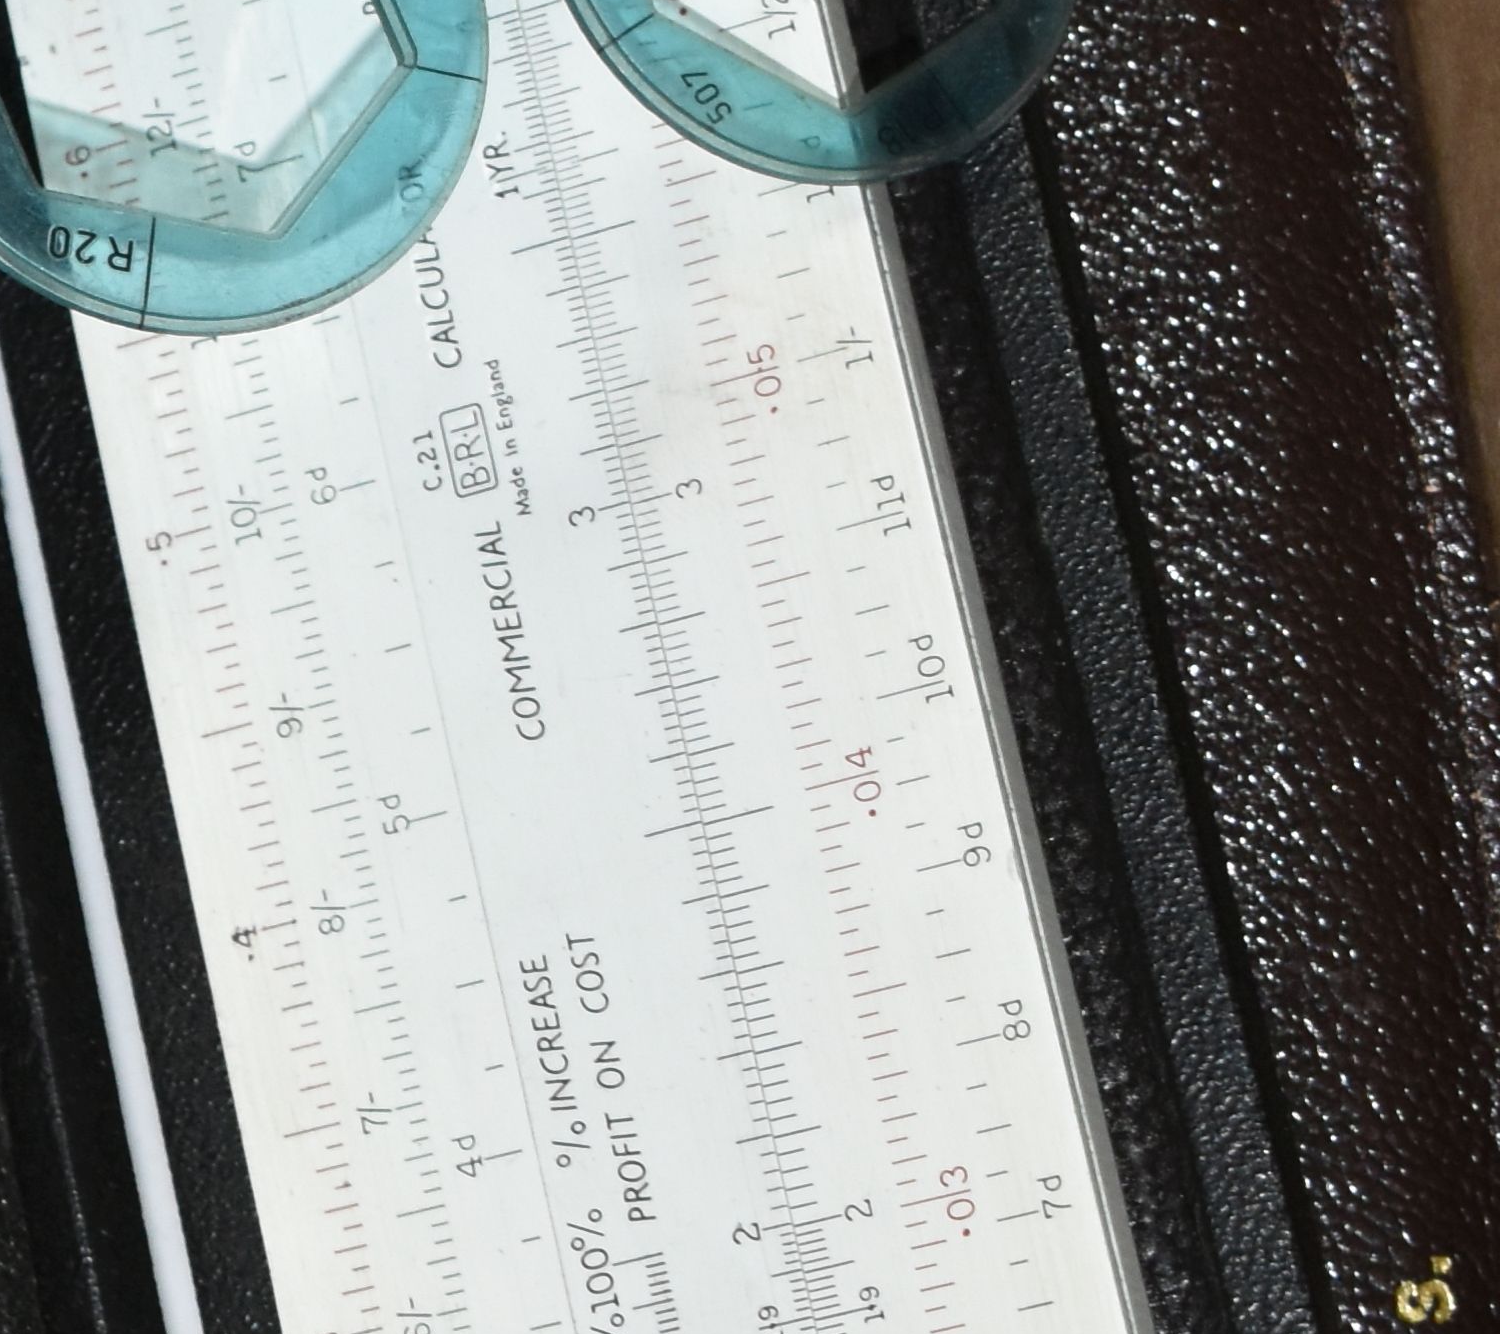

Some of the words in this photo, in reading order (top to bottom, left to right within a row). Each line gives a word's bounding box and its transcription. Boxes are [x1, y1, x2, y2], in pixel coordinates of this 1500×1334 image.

[483, 358, 515, 432] England
[503, 436, 519, 458] in
[507, 464, 533, 517] Made
[473, 519, 546, 742] COMMERCIAL
[563, 932, 610, 1015] COST
[518, 953, 578, 1113] INCREASE
[589, 1038, 627, 1091] ON
[603, 1112, 658, 1223] PROFIT
[566, 1207, 620, 1313] 100%
